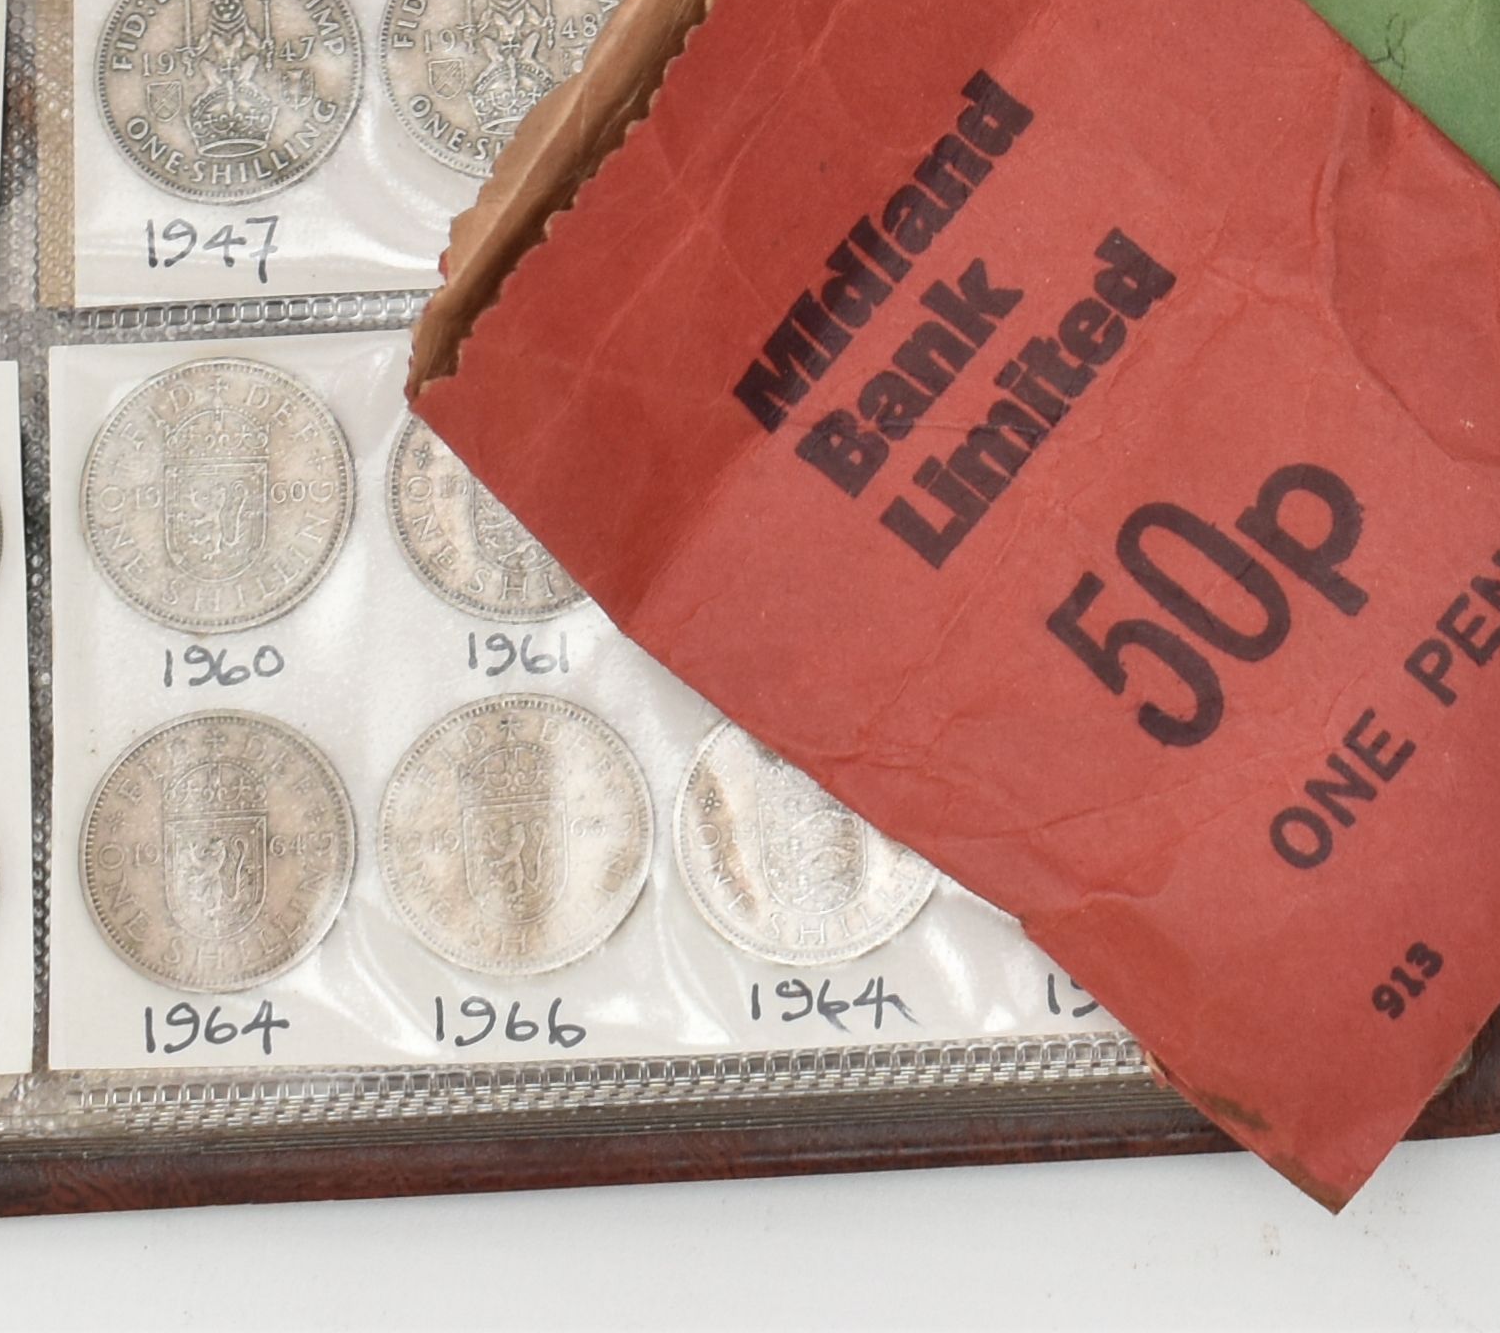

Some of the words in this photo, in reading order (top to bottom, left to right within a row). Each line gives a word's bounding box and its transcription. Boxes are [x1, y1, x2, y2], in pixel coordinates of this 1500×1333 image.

[147, 216, 278, 283] 1947
[733, 69, 1034, 434] Midland
[794, 256, 1025, 498] Bank
[878, 227, 1177, 570] Limited
[1045, 461, 1366, 748] 50p
[164, 645, 284, 687] 1960
[469, 633, 567, 676] 1961
[1269, 709, 1416, 872] ONE
[752, 977, 920, 1029] 1964
[1370, 941, 1444, 1018] 913
[145, 1001, 289, 1054] 1964
[436, 997, 586, 1048] 1966
